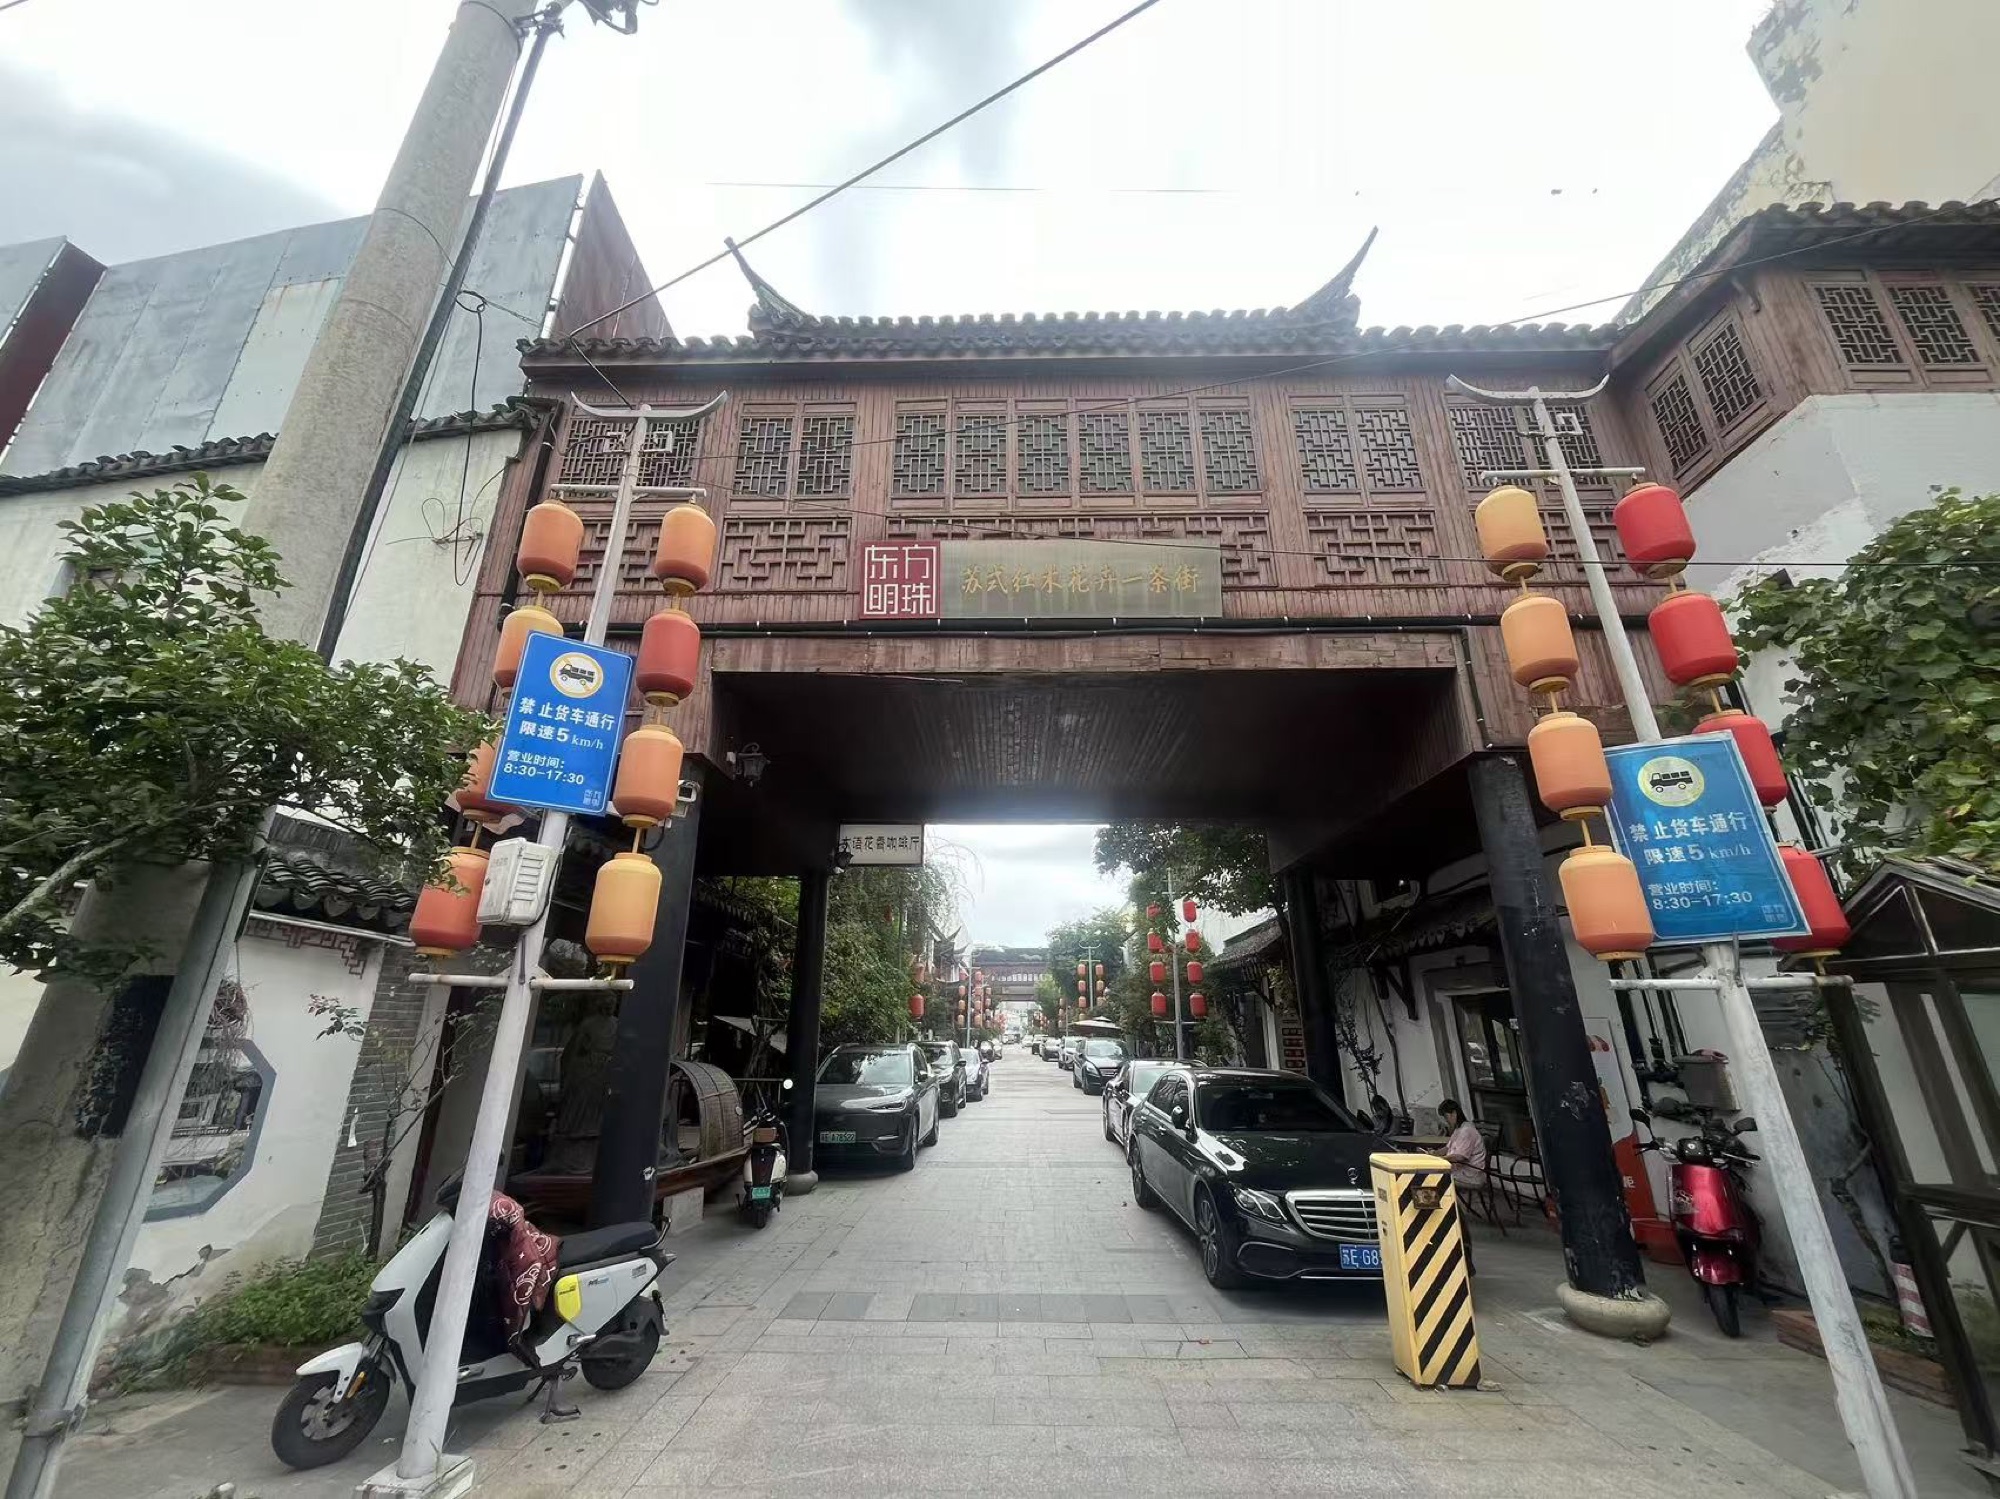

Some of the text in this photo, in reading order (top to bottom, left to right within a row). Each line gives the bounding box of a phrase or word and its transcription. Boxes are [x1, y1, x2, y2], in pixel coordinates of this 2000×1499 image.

[865, 582, 936, 615] 明珠
[519, 697, 616, 731] 禁止货车通行
[1629, 811, 1747, 843] 禁止货车通行
